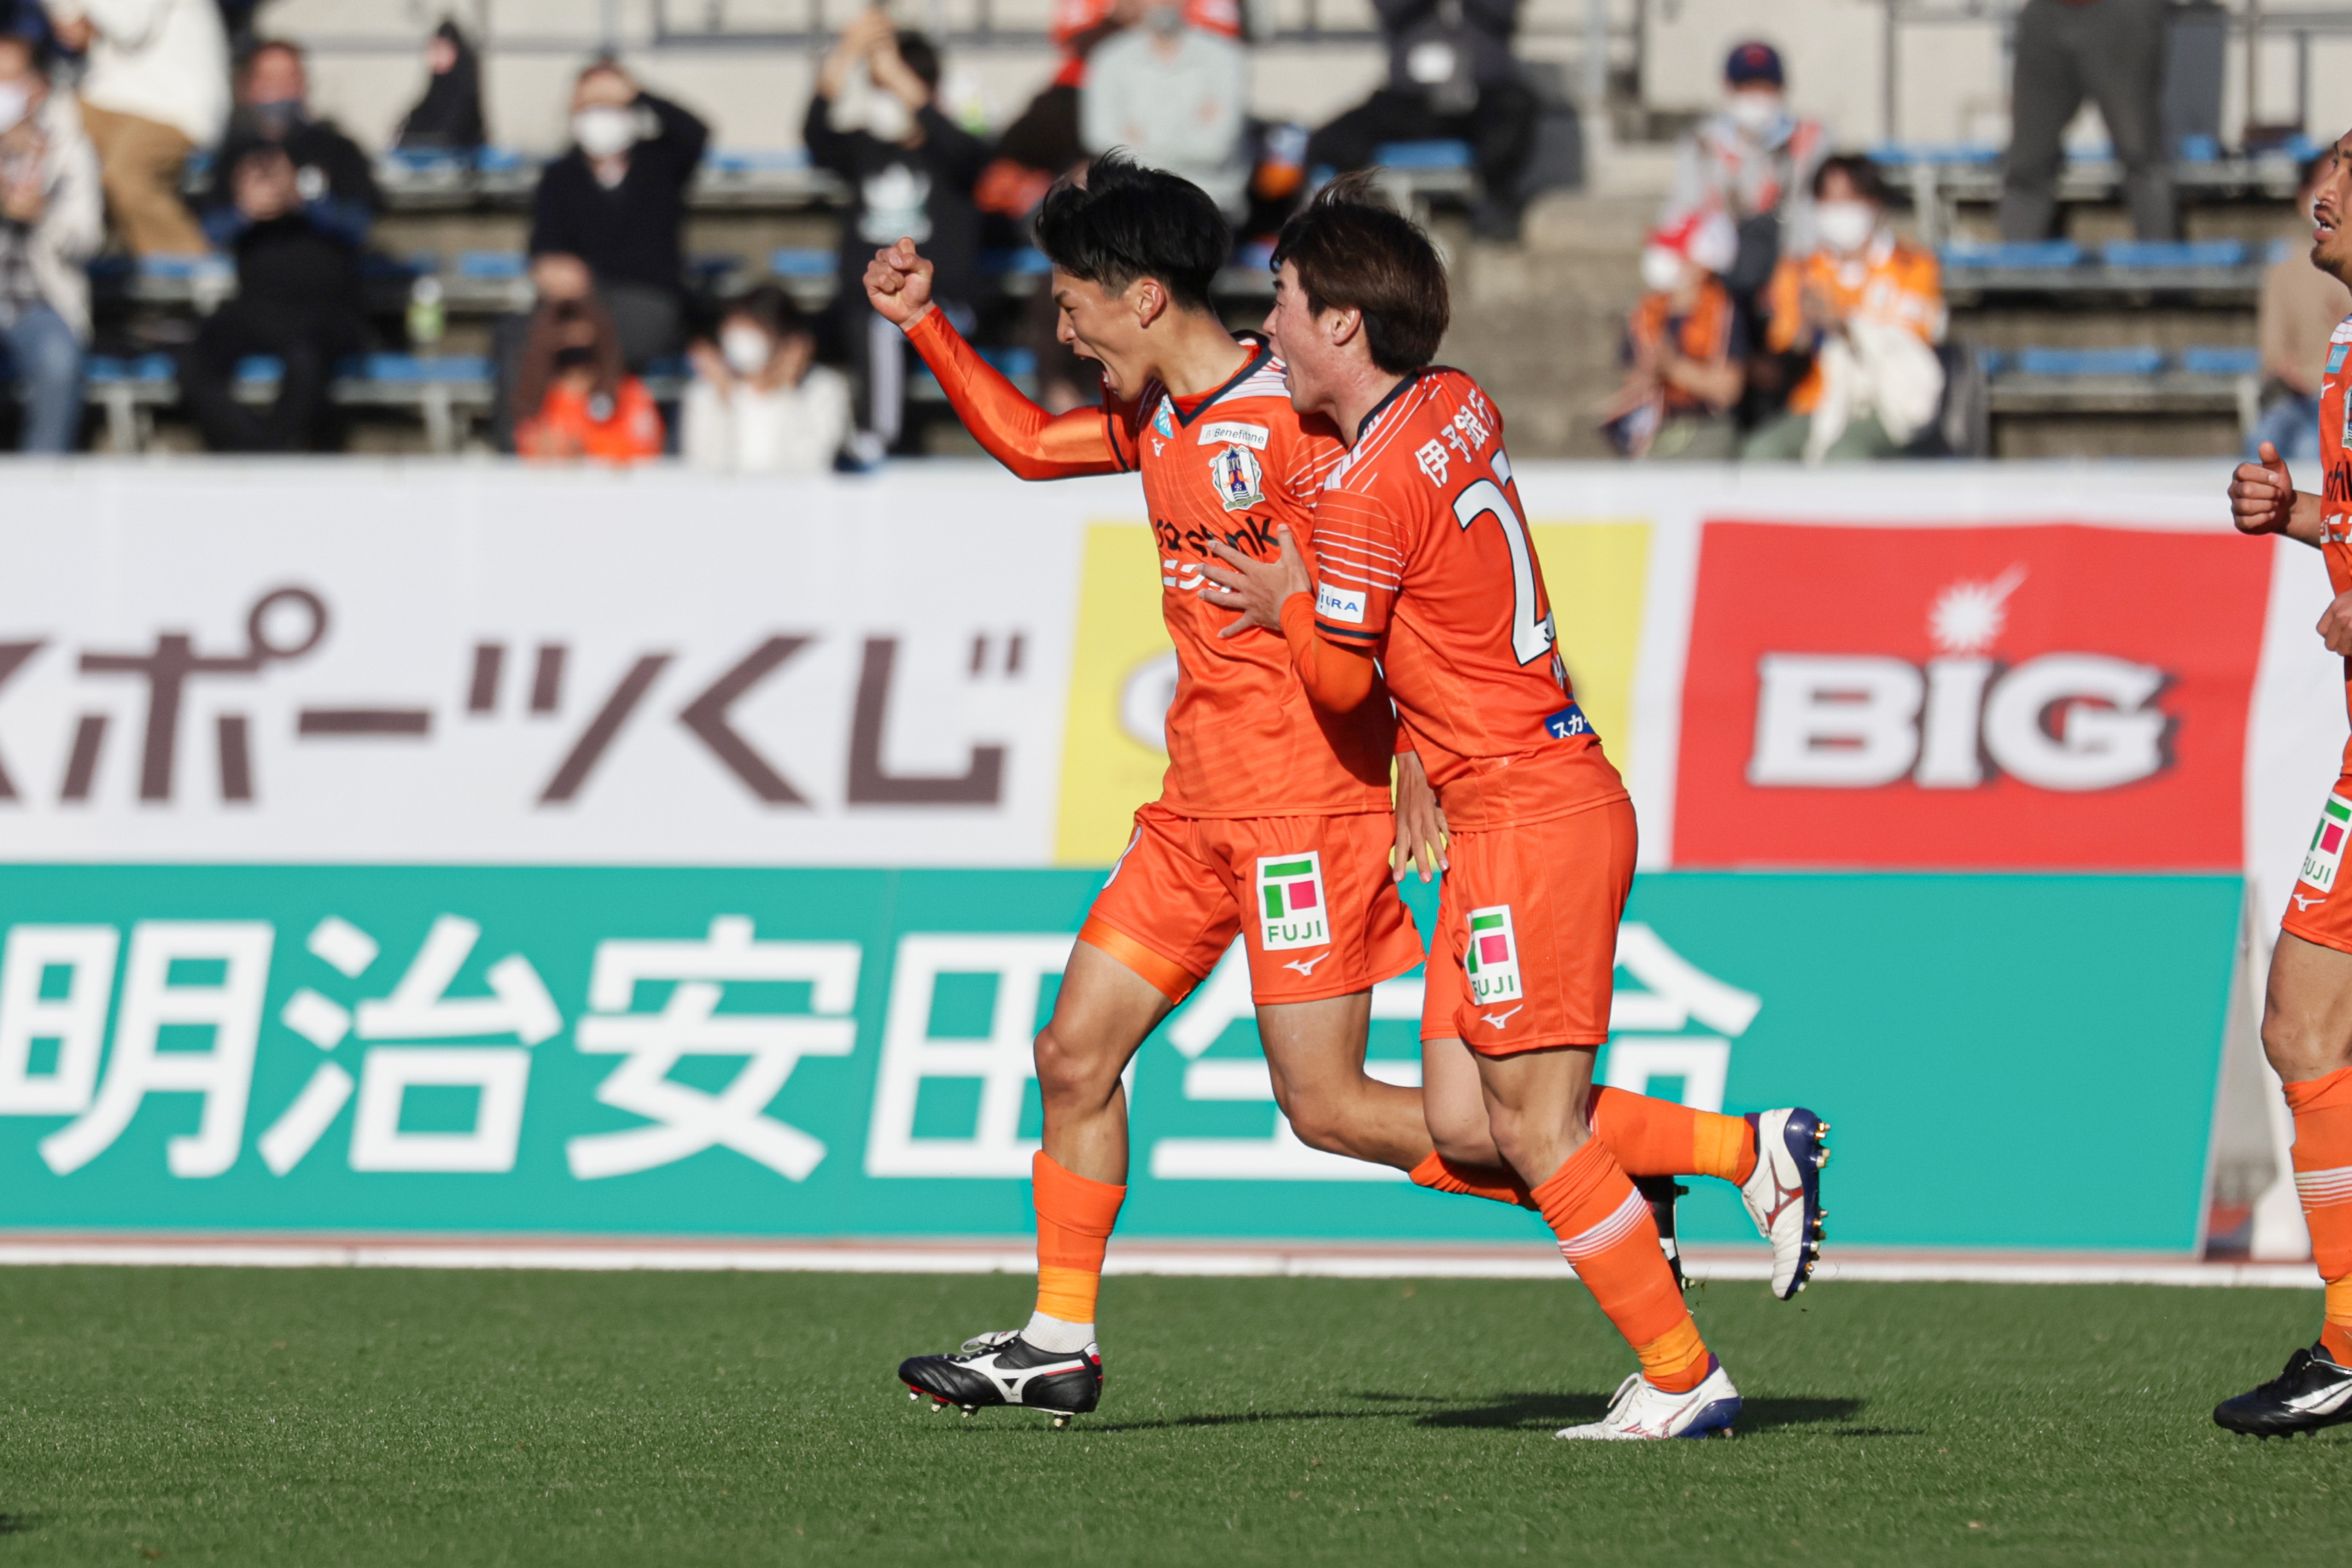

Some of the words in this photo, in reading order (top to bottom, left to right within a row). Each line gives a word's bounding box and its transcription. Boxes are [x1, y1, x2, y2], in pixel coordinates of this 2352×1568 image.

[1414, 388, 1495, 488] 伊予銀行
[1552, 714, 1588, 739] スカ
[2303, 856, 2331, 884] UJI
[1268, 920, 1321, 942] FUJI
